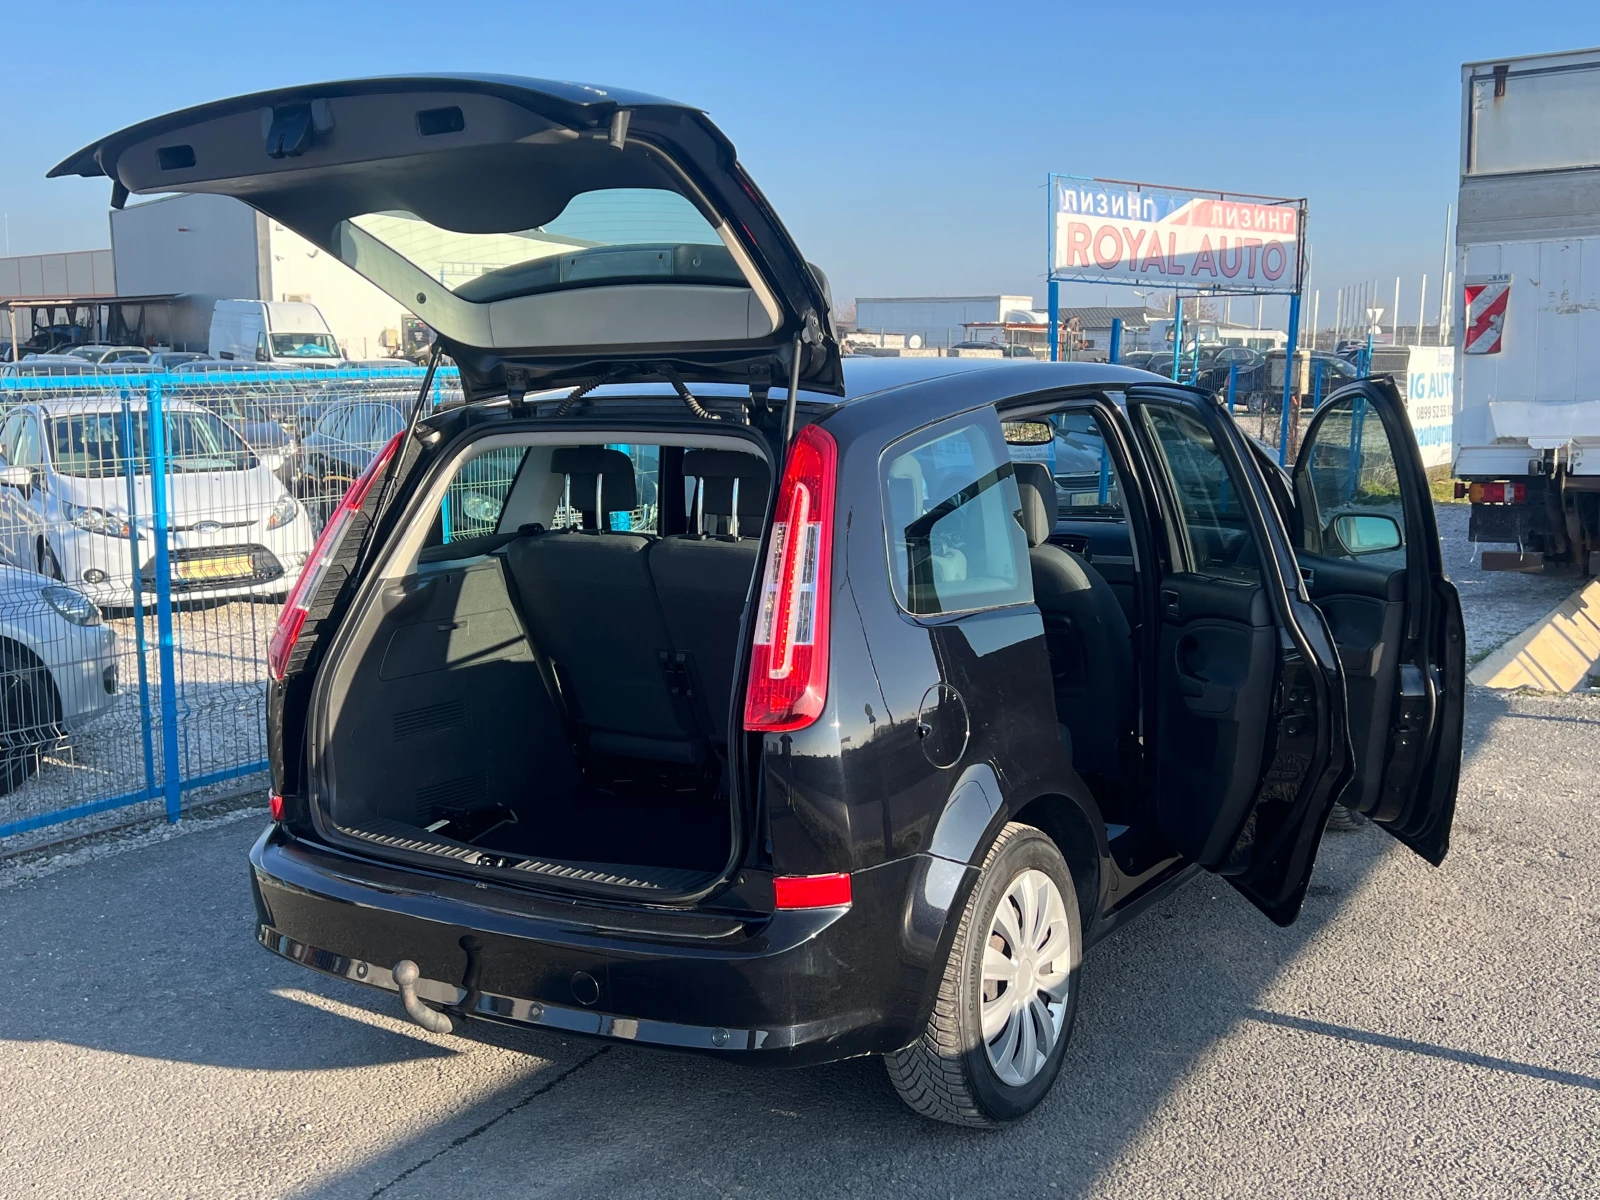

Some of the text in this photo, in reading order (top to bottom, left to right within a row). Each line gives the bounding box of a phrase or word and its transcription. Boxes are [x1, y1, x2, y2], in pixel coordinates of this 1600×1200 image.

[1063, 189, 1153, 219] ЛИЗИНГ
[1210, 205, 1292, 231] ЛИЗИНГ
[1067, 222, 1287, 281] ROYAL AUTO
[1409, 372, 1426, 400] IG
[1416, 405, 1432, 420] 0899
[1432, 405, 1440, 419] 52
[1440, 405, 1447, 418] 55
[968, 887, 998, 1011] ContiWinterContact
